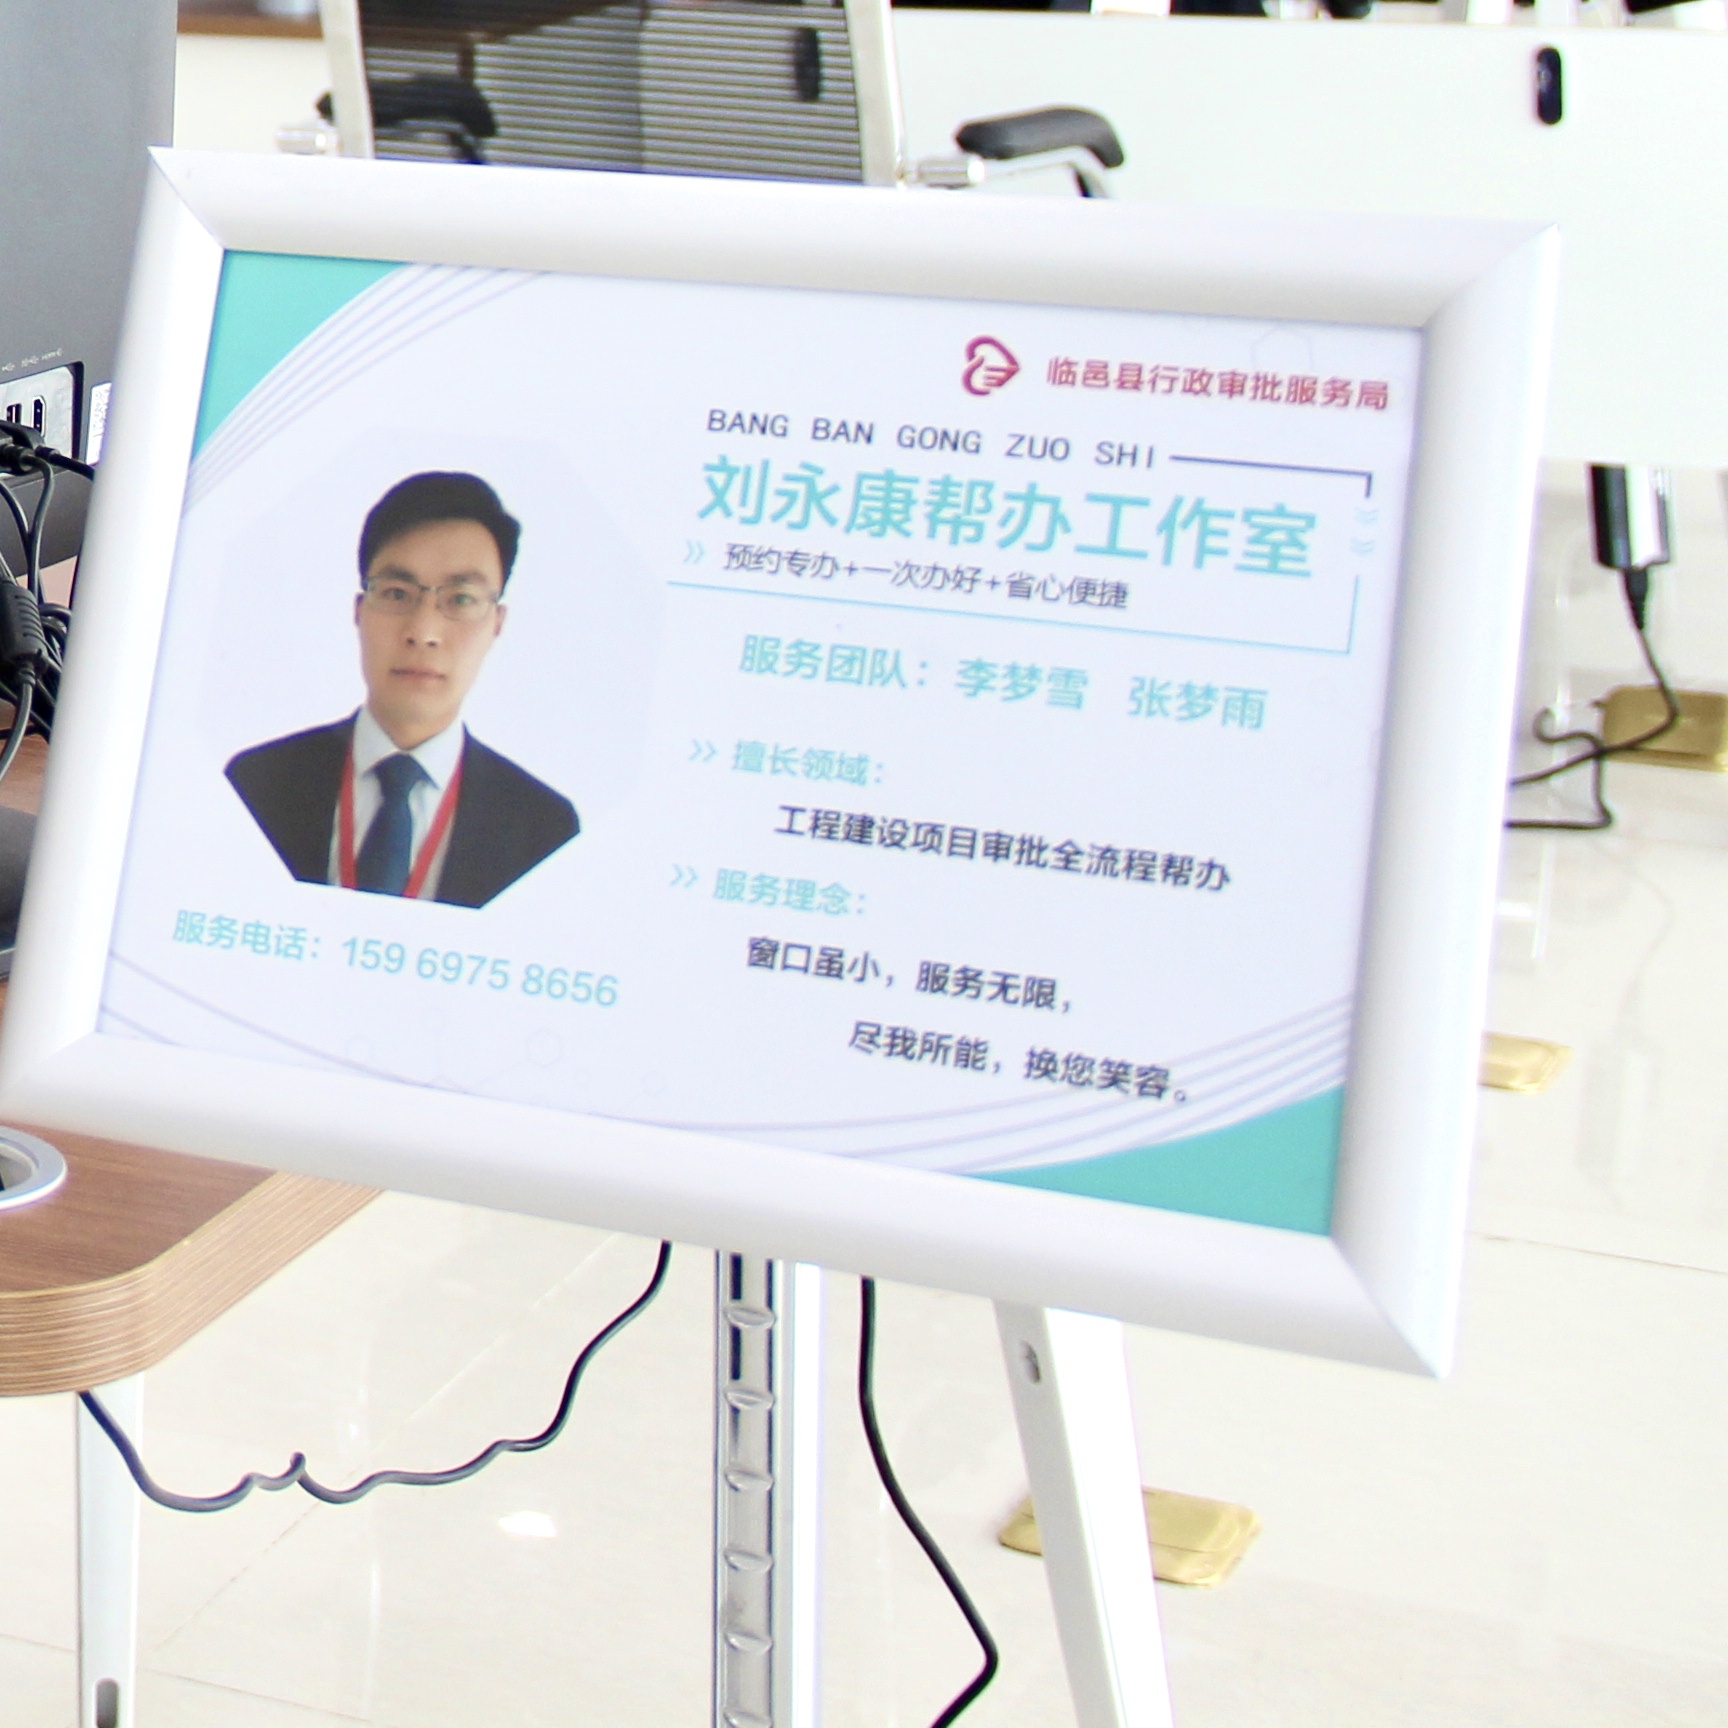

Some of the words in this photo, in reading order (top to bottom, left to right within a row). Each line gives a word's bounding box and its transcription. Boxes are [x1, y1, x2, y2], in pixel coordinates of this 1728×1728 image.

[1047, 356, 1389, 411] 临邑县行政审批服务局
[707, 409, 790, 438] BANG
[811, 418, 875, 444] BAN
[897, 425, 982, 454] GONG
[1005, 434, 1070, 461] ZUO
[1095, 441, 1154, 468] SHI
[697, 455, 1317, 578] 刘永康帮办工作室
[723, 543, 1129, 609] 预约专办+一次办好+省心便捷
[1127, 676, 1268, 731] 张梦雨
[731, 740, 885, 786] 擅长领域：
[774, 805, 1231, 892] 工程建设项目审批全流程帮办
[712, 868, 868, 916] 服务理念：
[416, 946, 511, 992] 6975
[521, 963, 620, 1008] 8656
[747, 936, 1071, 1014] 窗口虽小，服务无限，
[849, 1020, 1187, 1103] 尽我所能，换您笑容。
